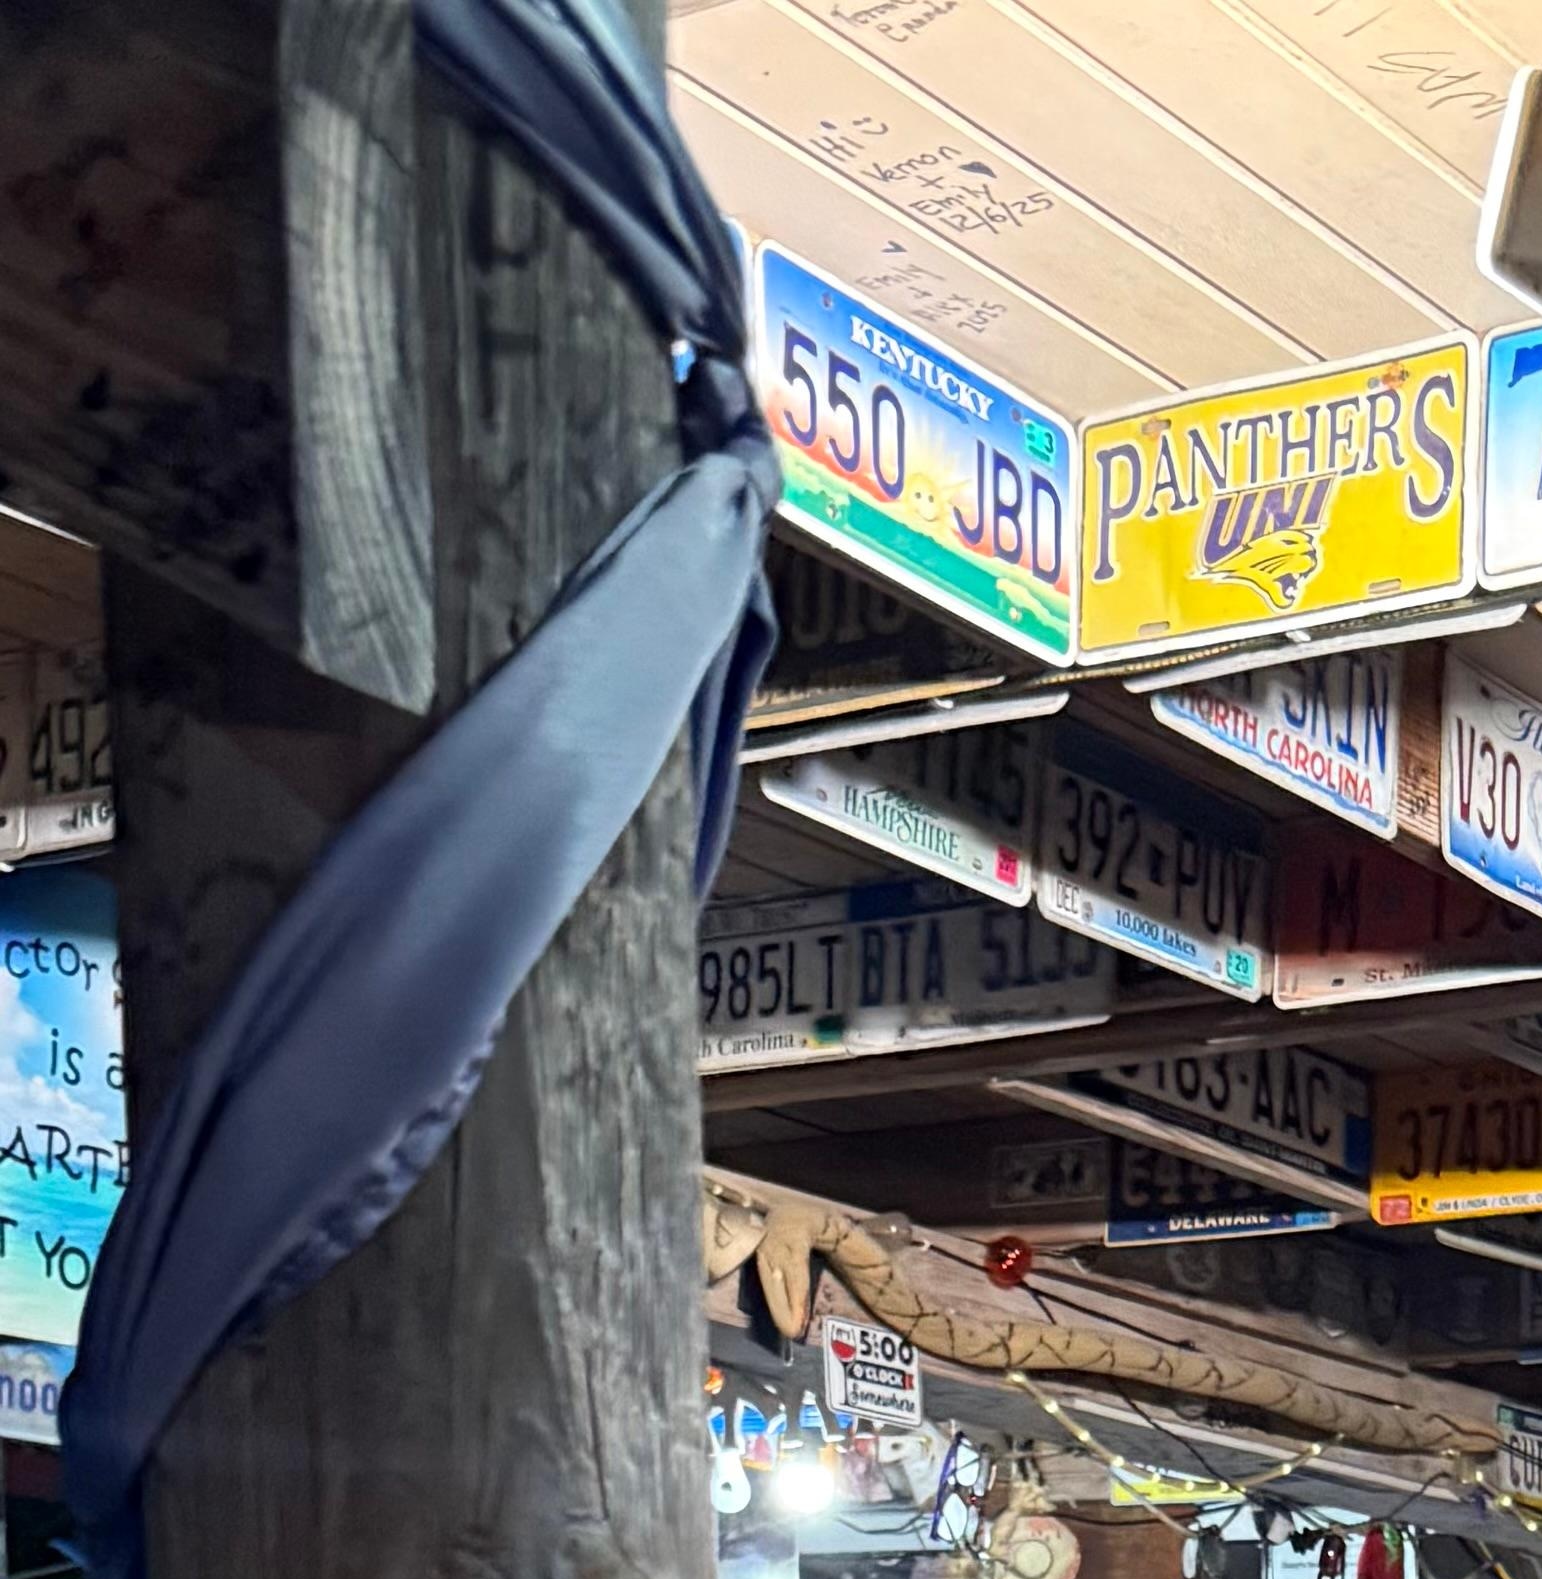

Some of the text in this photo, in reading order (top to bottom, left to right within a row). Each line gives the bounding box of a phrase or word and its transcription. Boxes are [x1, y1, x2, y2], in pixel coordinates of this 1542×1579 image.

[909, 184, 998, 217] Emily
[940, 192, 1054, 235] 12/6/25
[850, 315, 995, 421] KENTUCKY
[783, 321, 1062, 585] 550 JBD
[1093, 373, 1457, 582] PANTHERS
[1202, 475, 1333, 565] UNI
[1177, 688, 1374, 809] NORTH CAROLINA
[1457, 718, 1521, 850] V30
[844, 785, 961, 862] HAMPSHIRE
[1056, 879, 1079, 915] DEC
[1114, 908, 1197, 957] 10,000 lakes
[50, 1029, 84, 1086] is
[717, 1031, 796, 1056] Carolina
[1168, 1213, 1271, 1232] DELAWARE
[860, 1330, 914, 1367] 5:00
